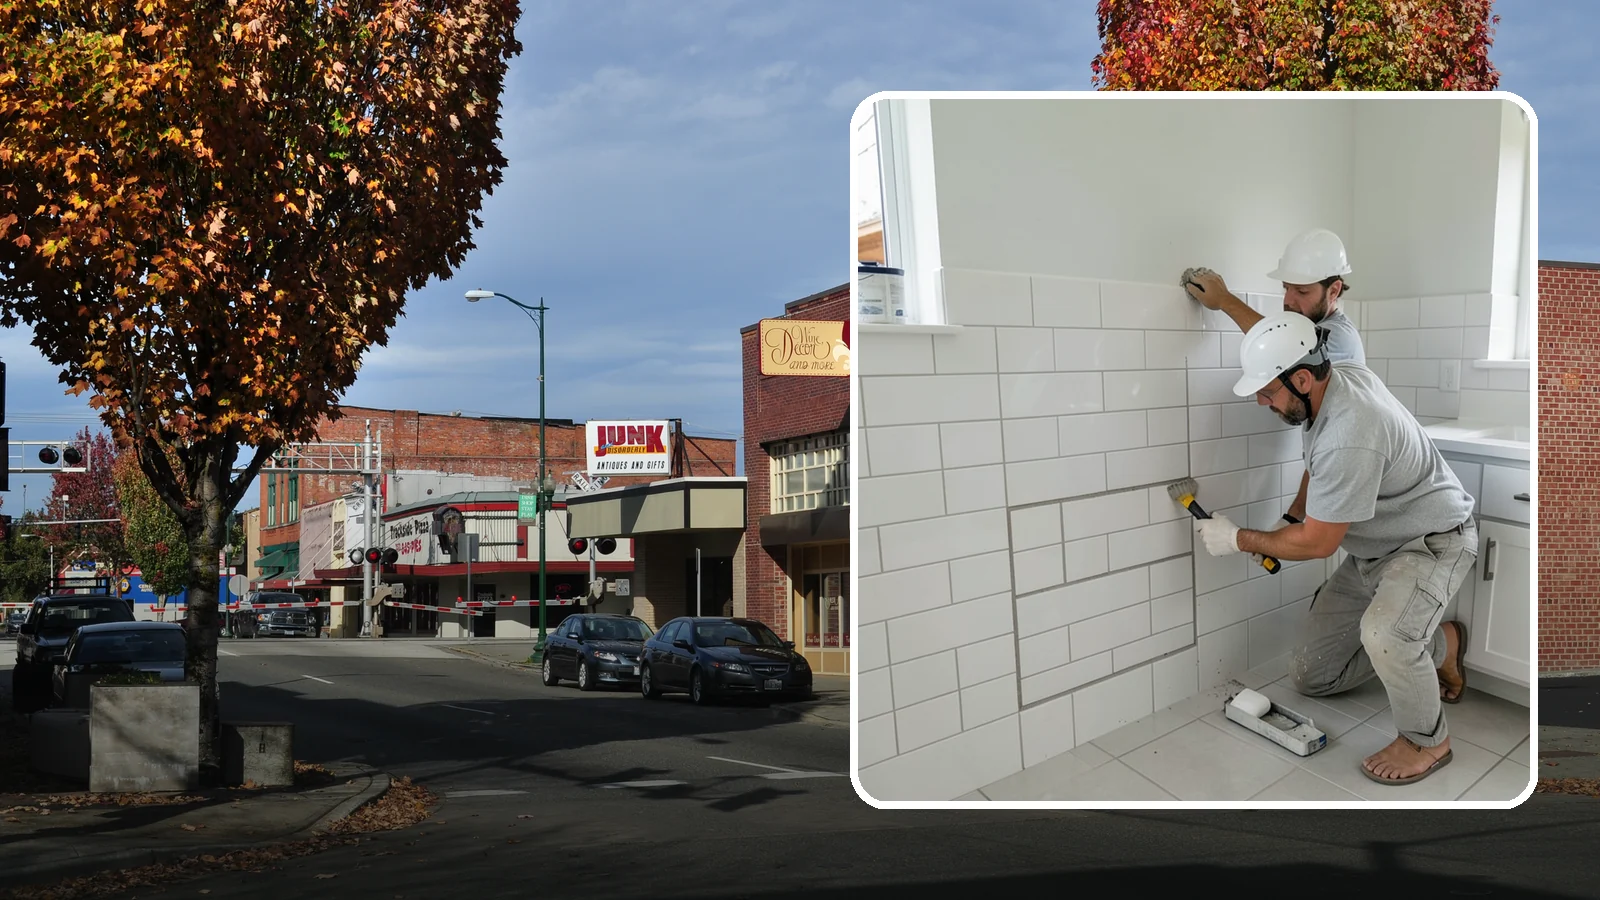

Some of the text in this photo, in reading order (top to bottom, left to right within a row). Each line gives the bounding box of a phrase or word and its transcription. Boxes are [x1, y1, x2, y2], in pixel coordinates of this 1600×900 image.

[596, 425, 665, 457] JUNK
[607, 446, 646, 454] DISORDERLY
[597, 460, 665, 470] ANTIQUES AND GIFTS
[390, 519, 429, 540] Trackside Pizza
